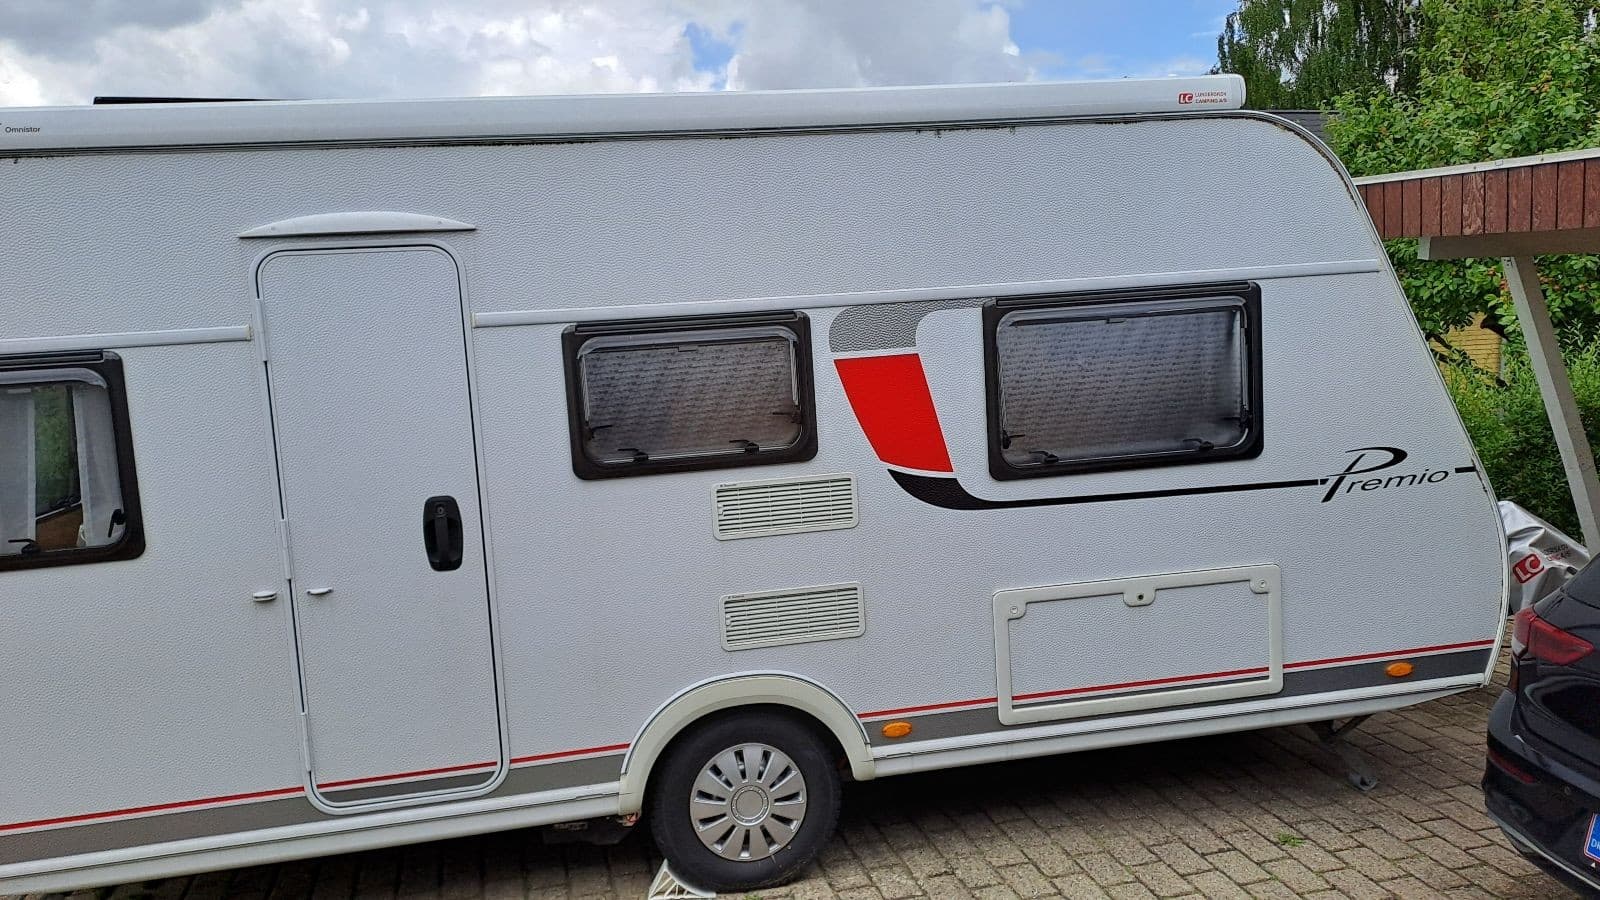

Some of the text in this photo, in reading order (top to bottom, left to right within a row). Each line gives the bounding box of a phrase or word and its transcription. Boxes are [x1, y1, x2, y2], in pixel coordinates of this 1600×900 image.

[1179, 93, 1193, 104] LC
[1321, 446, 1449, 503] Premio
[1515, 555, 1543, 581] LC
